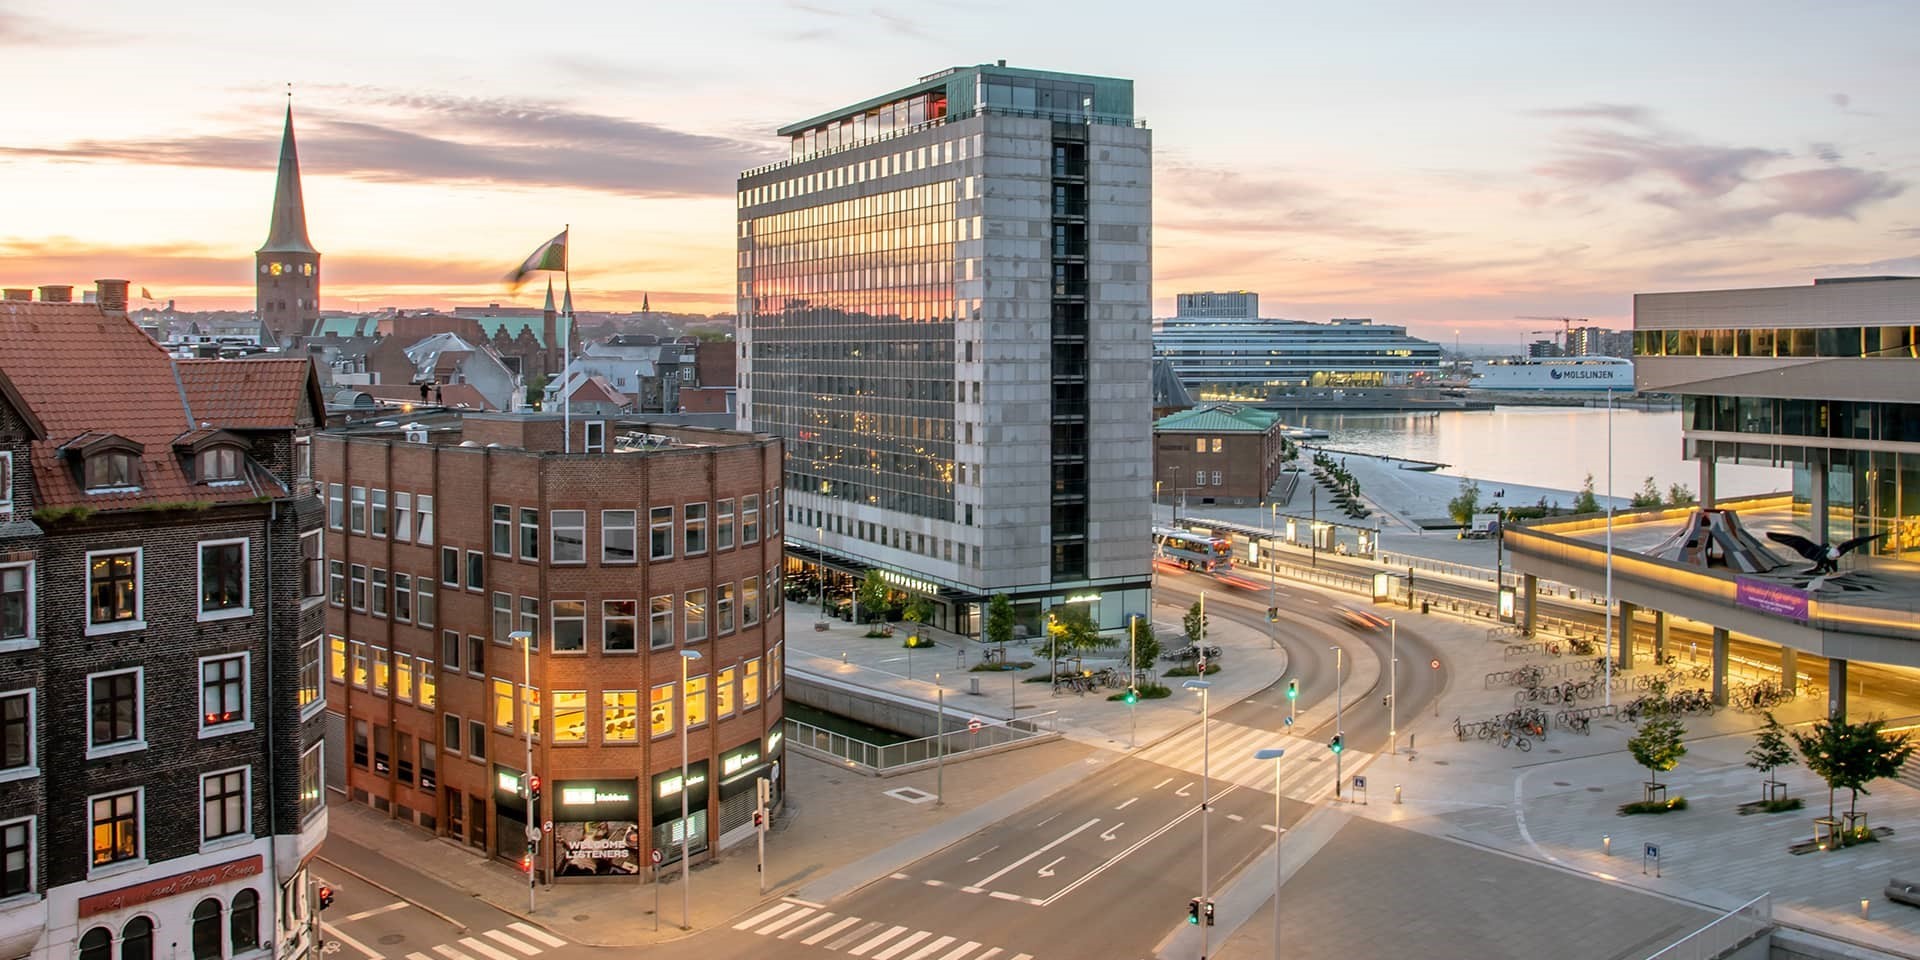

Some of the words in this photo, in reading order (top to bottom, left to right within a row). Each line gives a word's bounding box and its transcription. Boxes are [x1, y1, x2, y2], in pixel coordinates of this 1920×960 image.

[1563, 371, 1613, 379] MOLSLINJEN
[569, 840, 626, 850] WELCOME
[565, 849, 629, 859] LISTENERS
[179, 876, 216, 889] Hong
